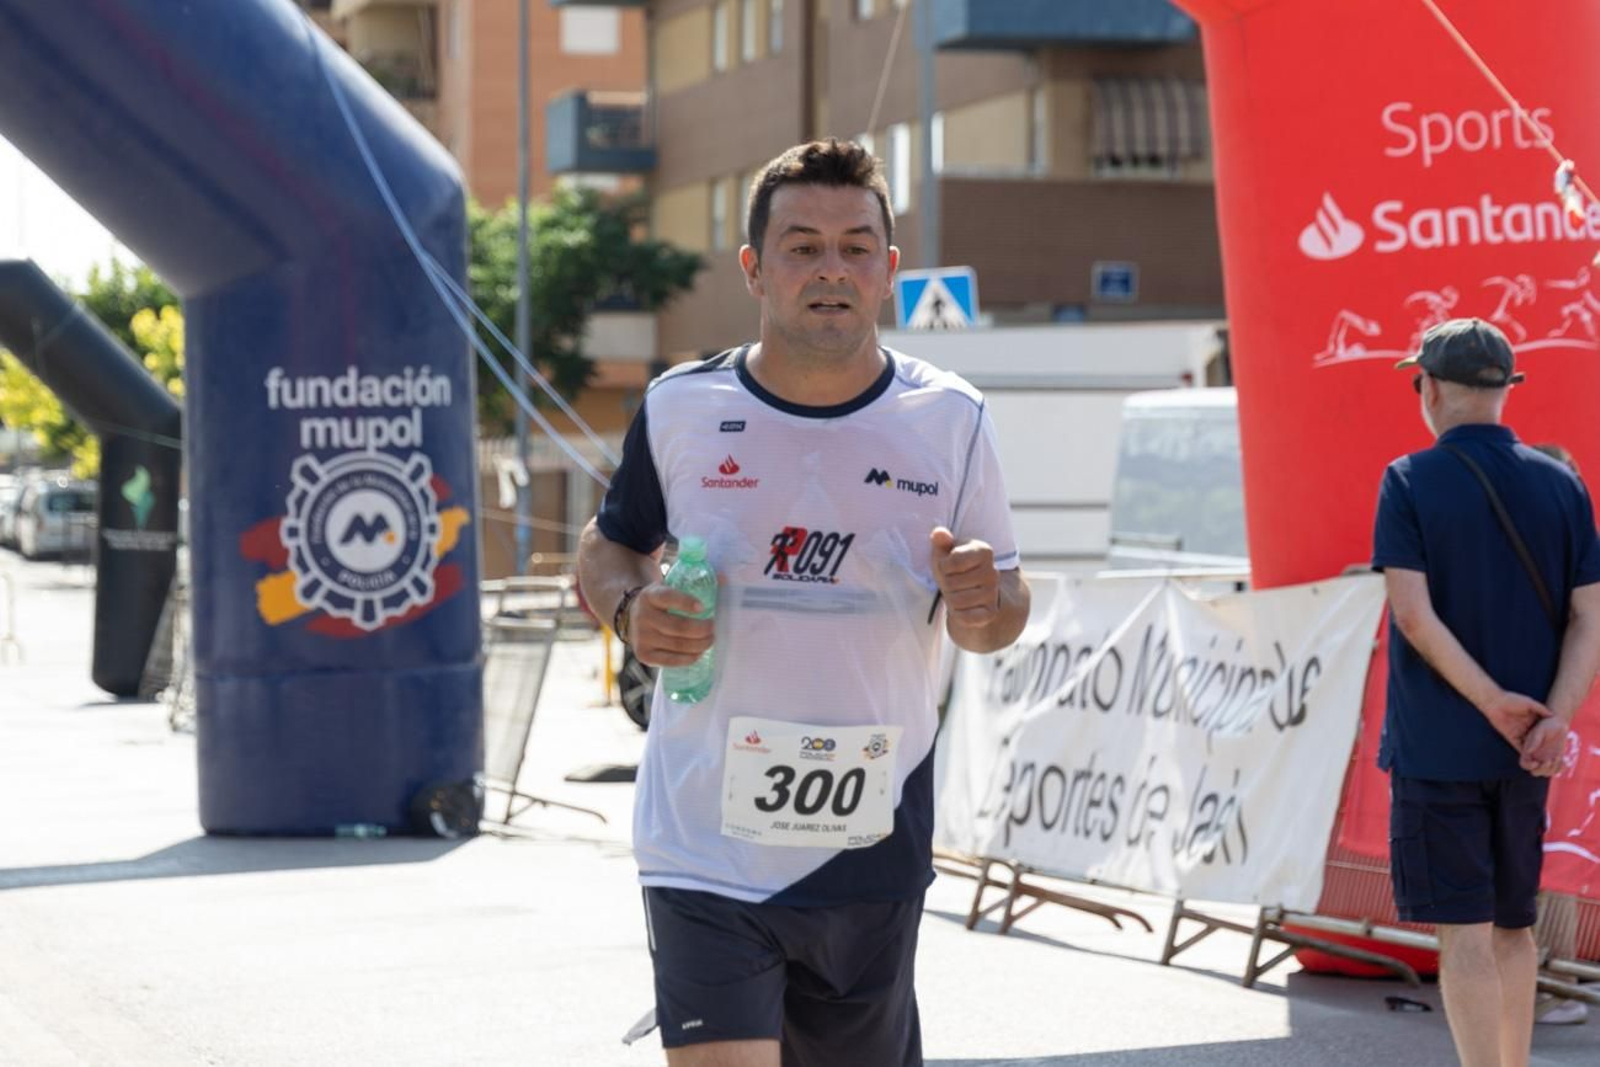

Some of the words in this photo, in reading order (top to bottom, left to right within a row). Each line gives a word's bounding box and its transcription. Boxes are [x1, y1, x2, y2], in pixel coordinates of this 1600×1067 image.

[1381, 102, 1554, 168] Sports
[265, 366, 452, 409] fundación
[300, 407, 422, 455] mupol
[701, 476, 759, 489] Santander
[897, 479, 939, 497] mupol
[754, 765, 865, 816] 300
[976, 755, 1125, 848] eportes
[770, 821, 790, 831] JOSE
